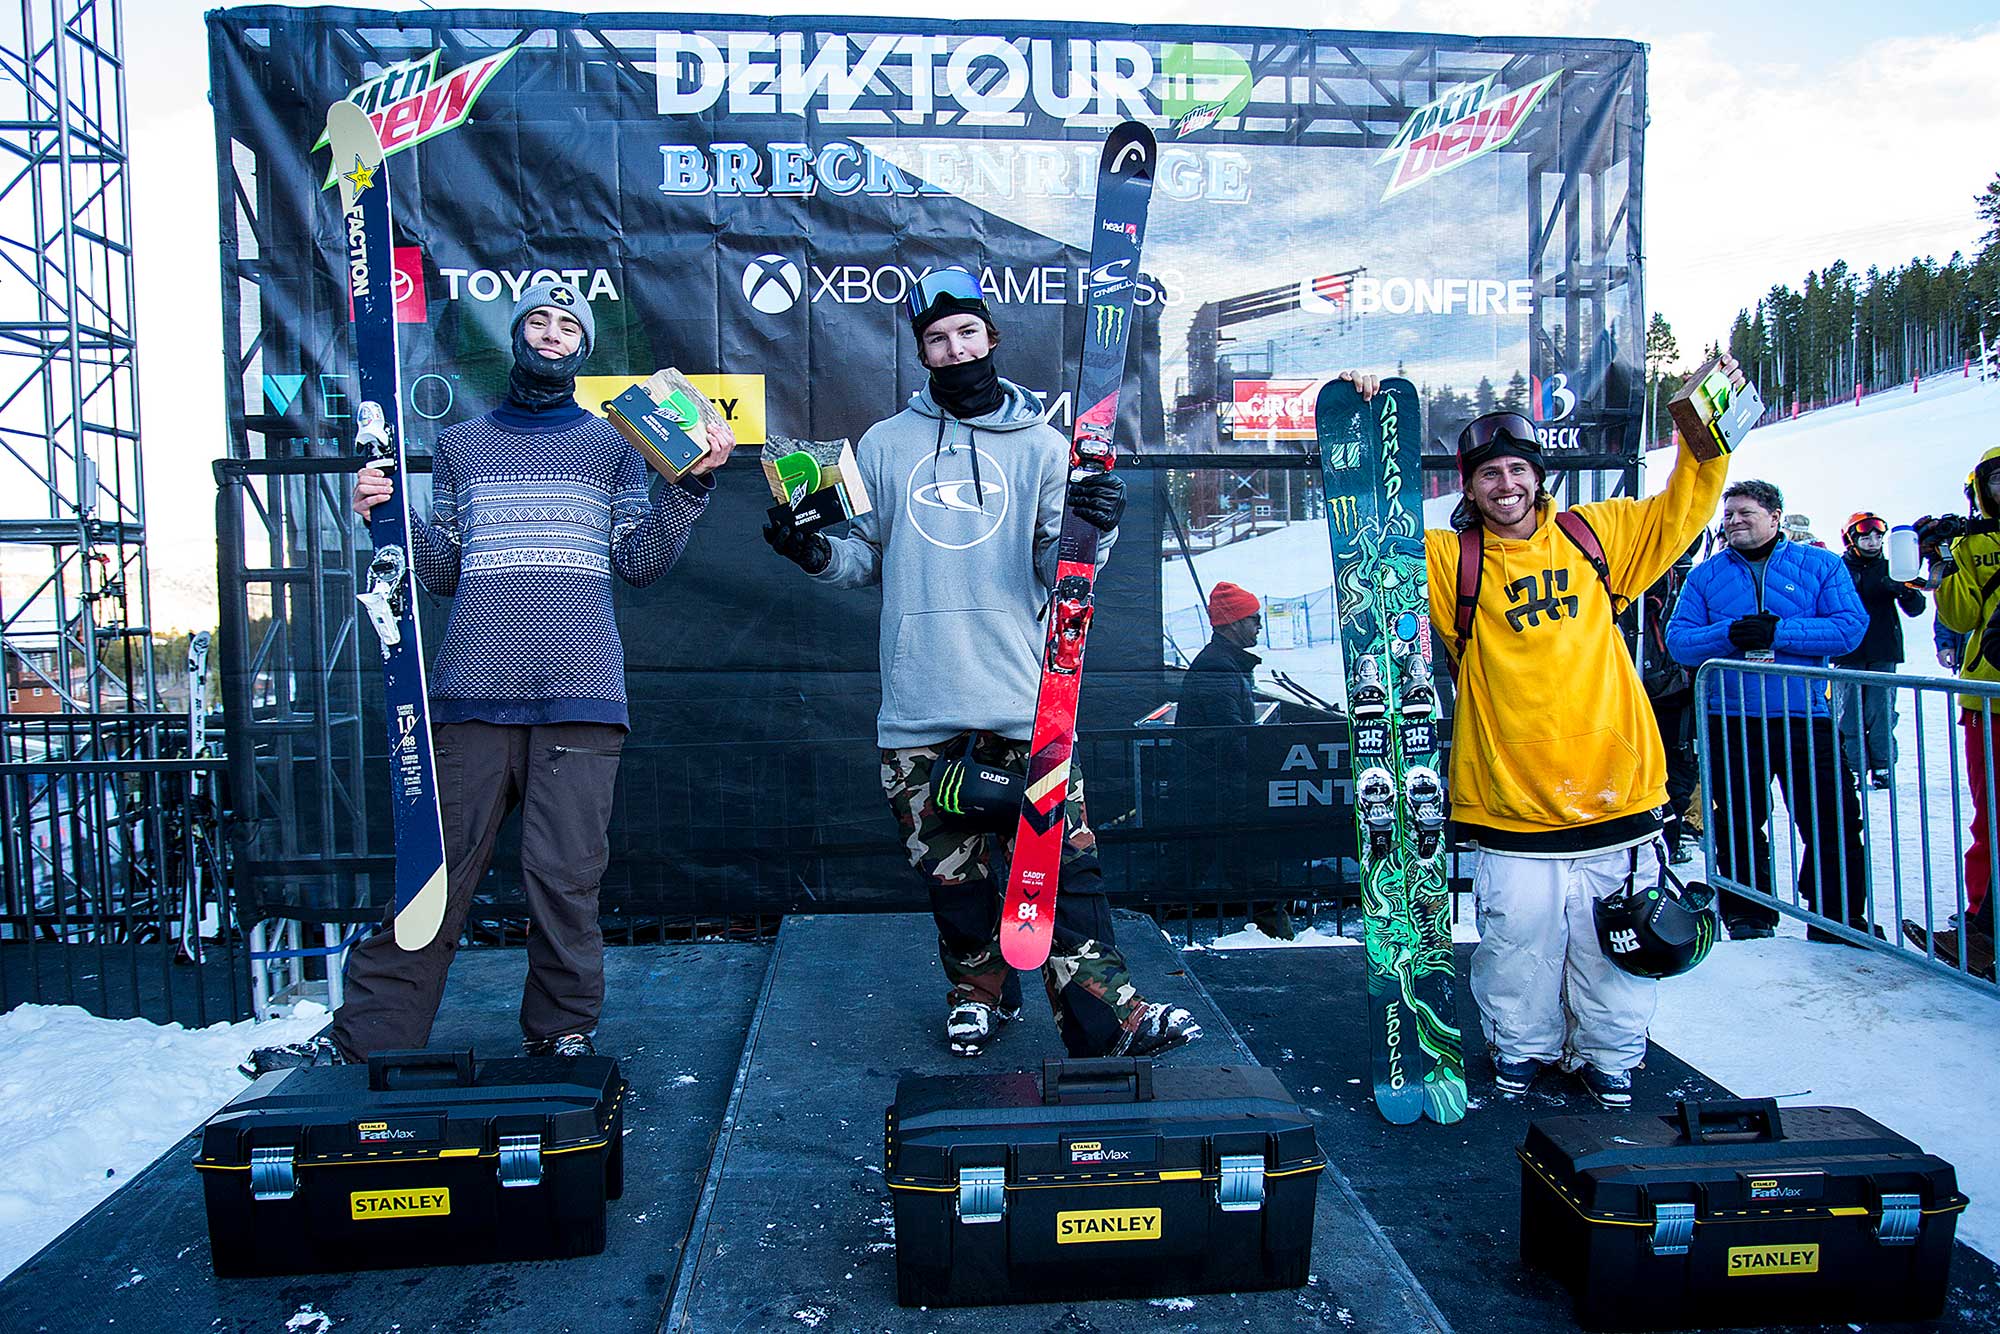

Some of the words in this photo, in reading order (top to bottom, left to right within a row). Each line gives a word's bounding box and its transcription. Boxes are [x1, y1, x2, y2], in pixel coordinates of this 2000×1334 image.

[659, 141, 1252, 204] BRECKENRIGE
[1102, 218, 1125, 234] head
[348, 203, 370, 298] FACTION
[945, 265, 1067, 304] AME
[1353, 278, 1534, 316] BONFIRE
[262, 373, 454, 419] VEO
[1379, 392, 1405, 522] ARMADA
[980, 771, 1010, 785] GIRO
[1022, 870, 1046, 880] CADDY
[1018, 902, 1038, 921] 84
[1385, 1000, 1405, 1090] EDOLLO
[360, 1129, 414, 1140] FatMax
[1071, 1150, 1129, 1161] FatMax
[1751, 1187, 1801, 1198] FatMax
[355, 1194, 444, 1212] STANLEY
[1061, 1216, 1156, 1234] STANLEY
[1731, 1251, 1814, 1269] STANLEY
